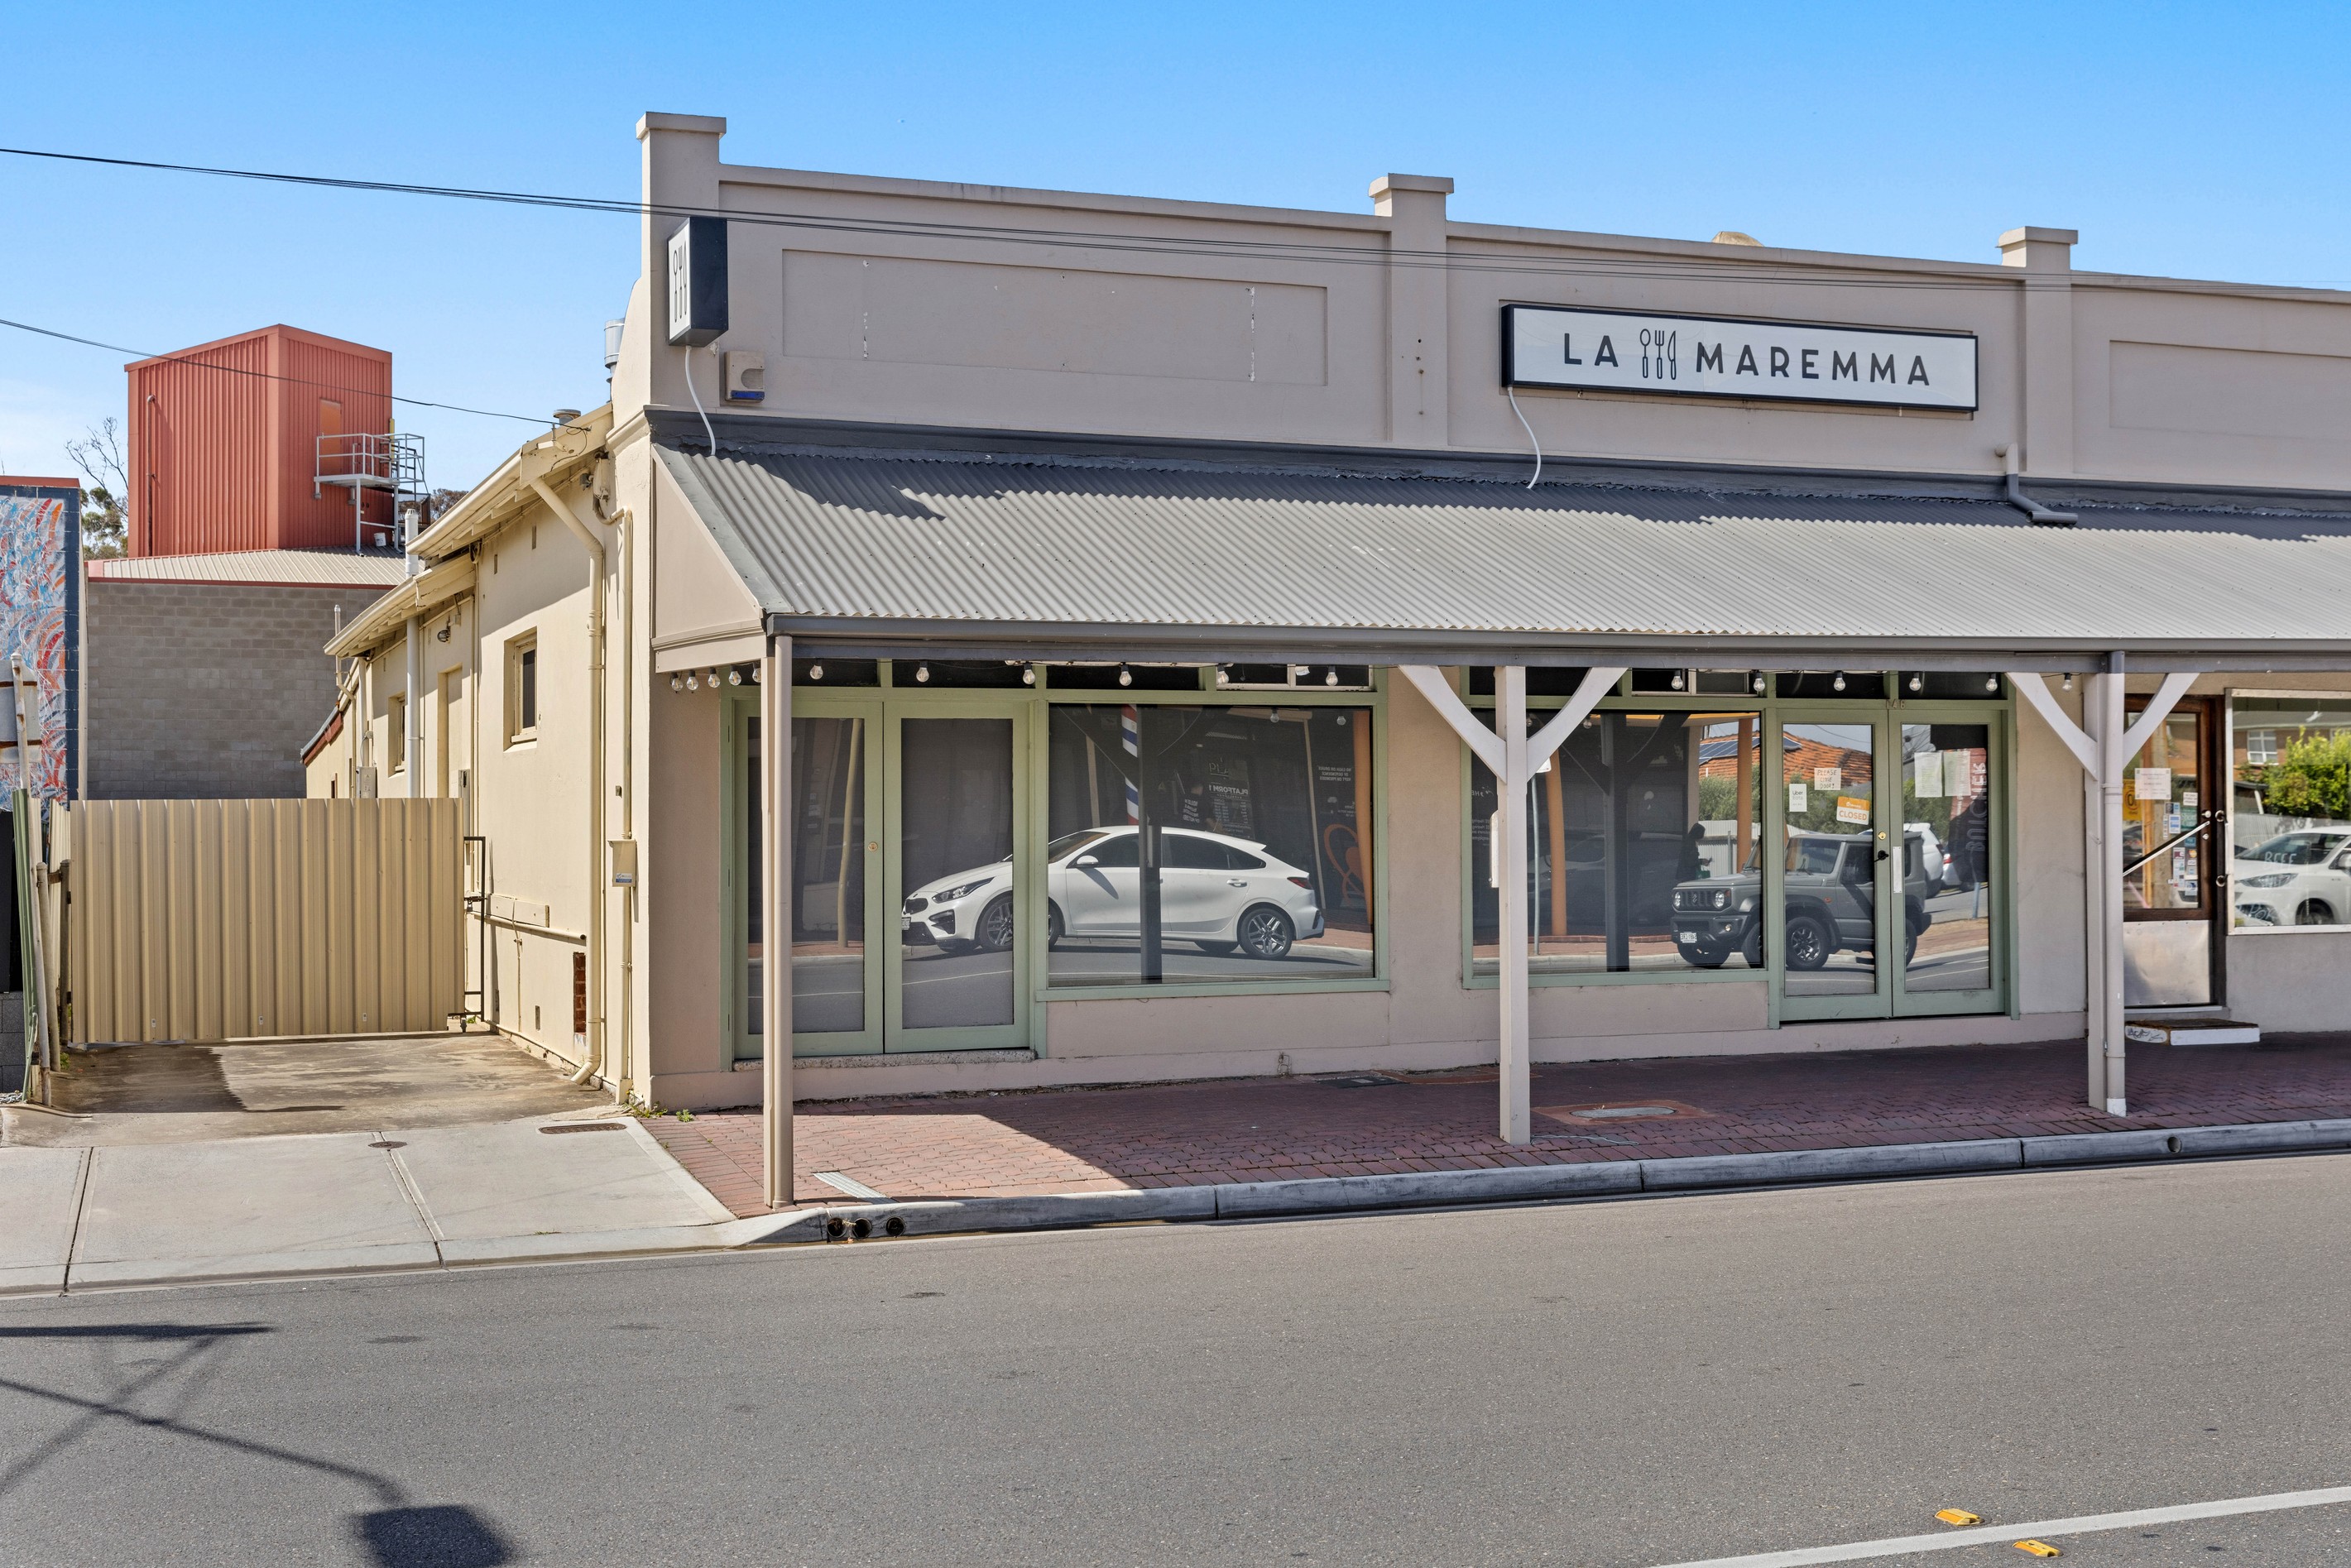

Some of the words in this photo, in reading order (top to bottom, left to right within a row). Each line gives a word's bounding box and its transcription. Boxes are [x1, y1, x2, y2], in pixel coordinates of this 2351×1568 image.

[1564, 333, 1619, 367] LA
[1696, 341, 1931, 386] MAREMMA
[1839, 810, 1868, 821] CLOSED
